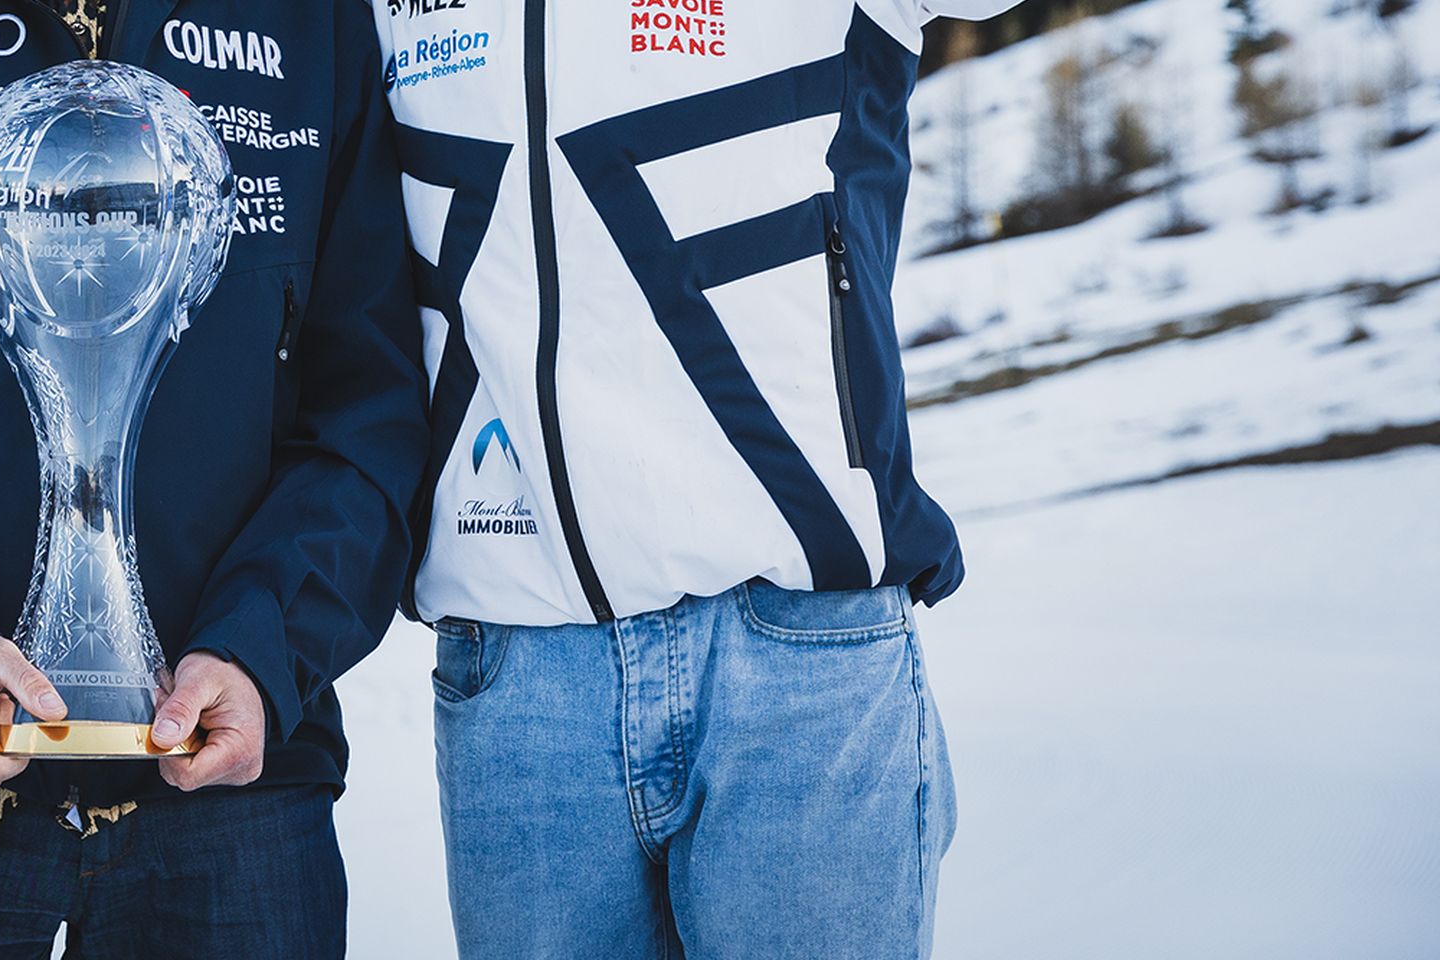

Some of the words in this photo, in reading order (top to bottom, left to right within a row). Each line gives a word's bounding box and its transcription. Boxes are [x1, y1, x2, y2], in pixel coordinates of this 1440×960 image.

[631, 12, 706, 36] MONT
[164, 19, 285, 79] COLMAR
[416, 29, 490, 66] Région
[631, 33, 727, 58] BLANC
[397, 54, 487, 90] vergne-Rhône-Alpes
[215, 123, 321, 150] 'EPARGNE
[75, 674, 122, 685] WORLD
